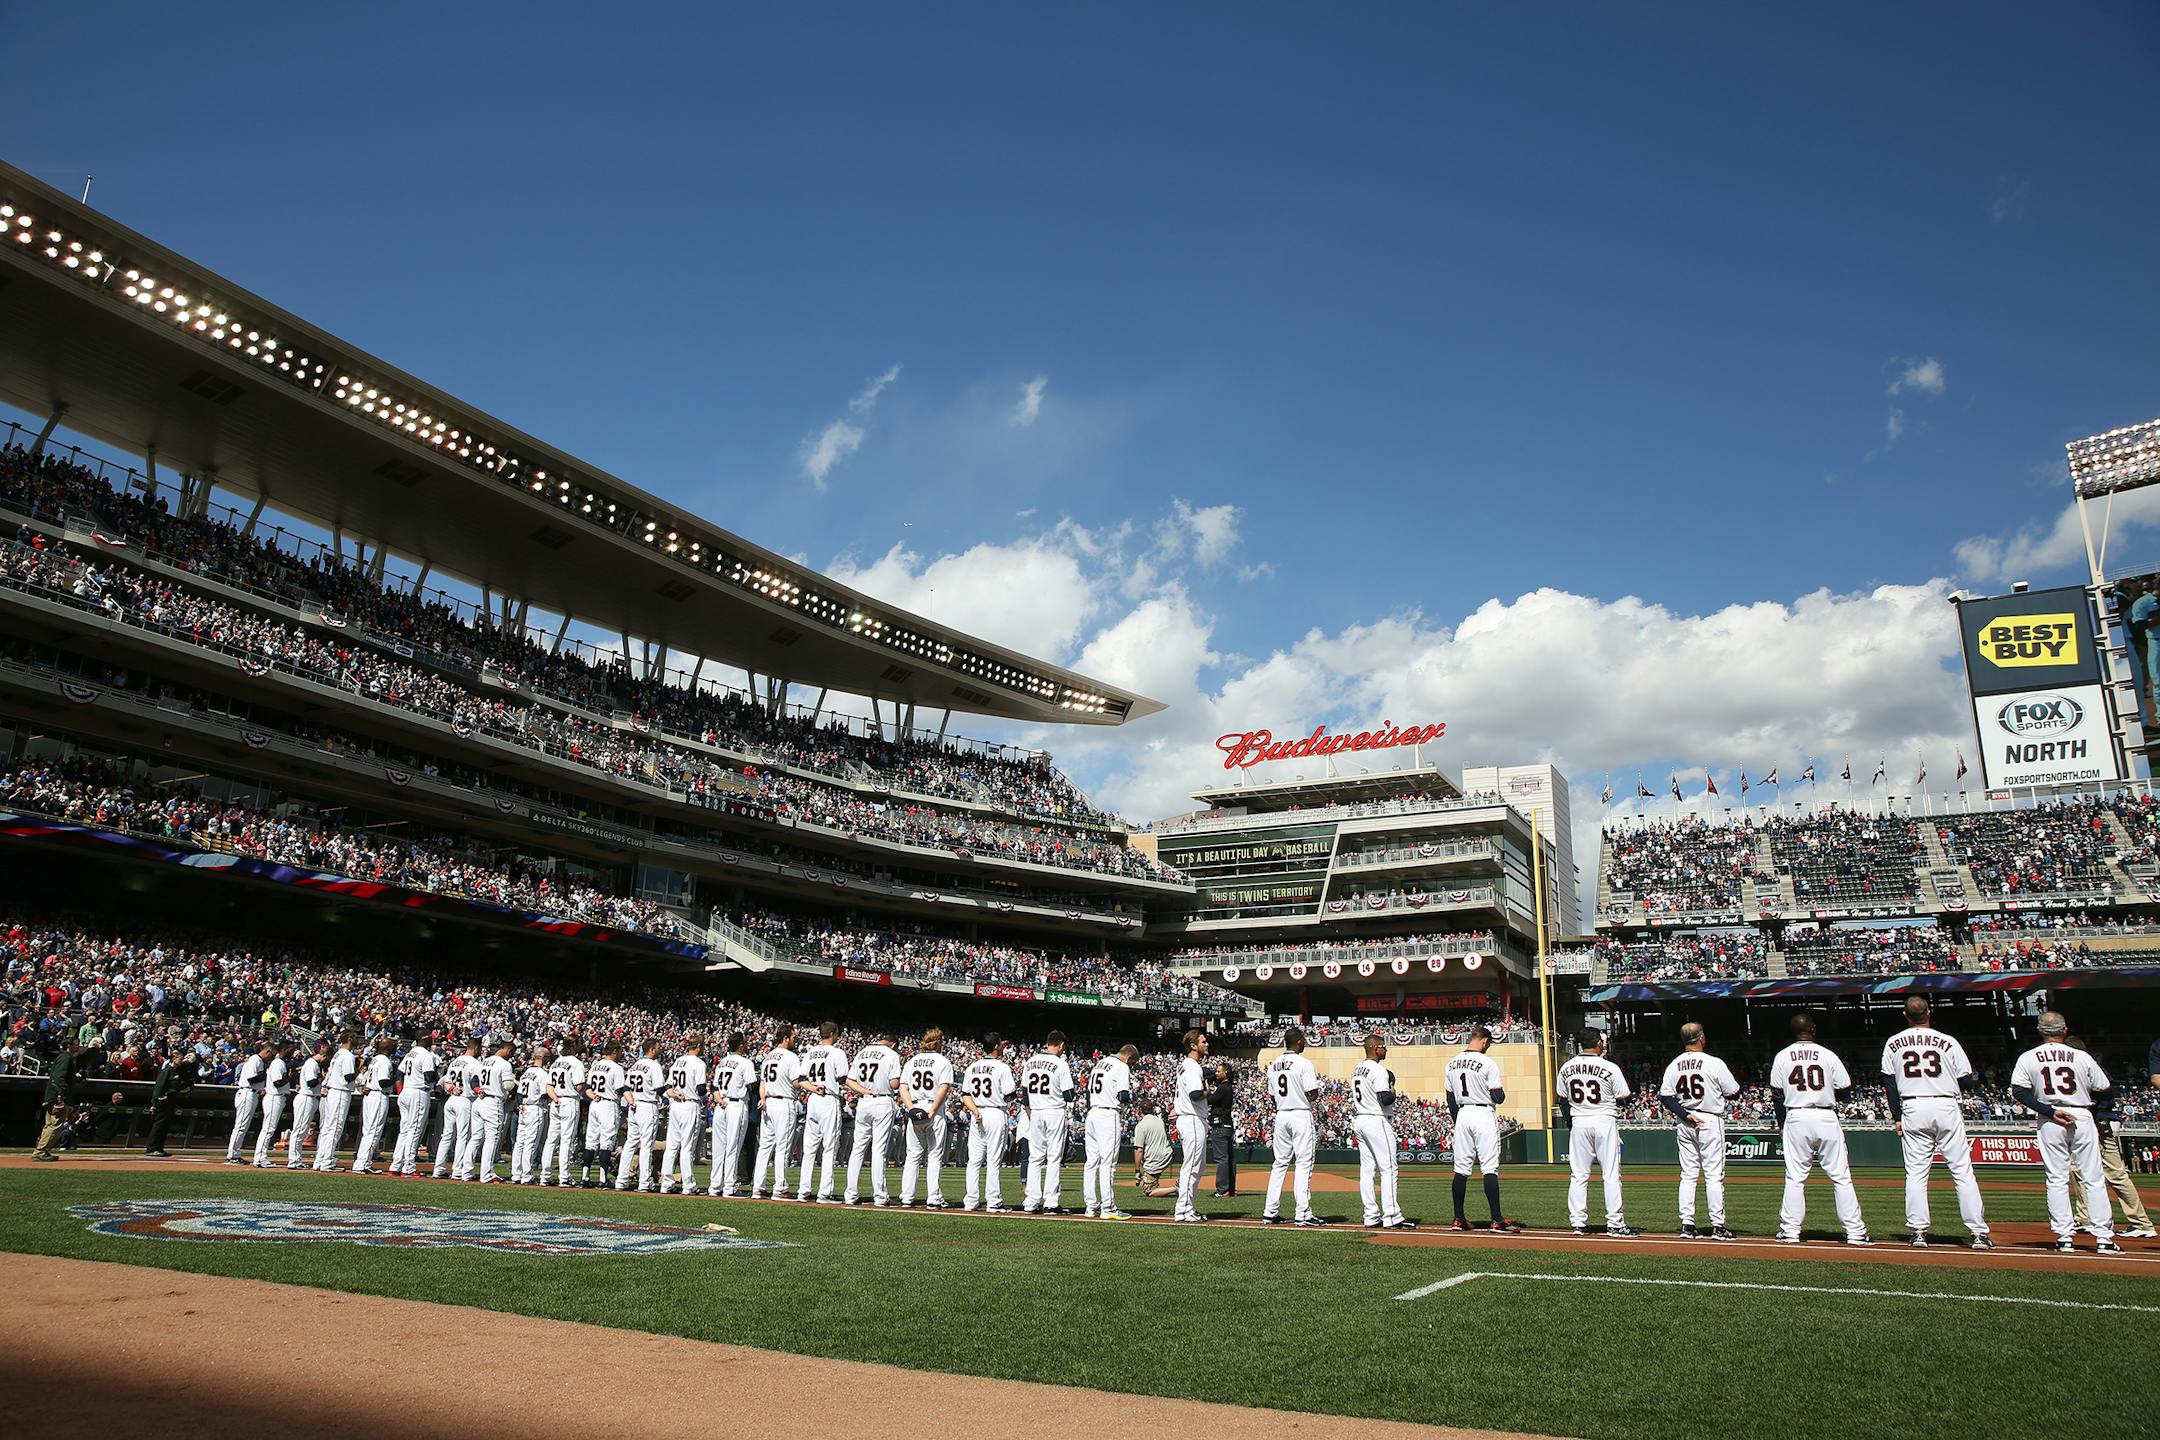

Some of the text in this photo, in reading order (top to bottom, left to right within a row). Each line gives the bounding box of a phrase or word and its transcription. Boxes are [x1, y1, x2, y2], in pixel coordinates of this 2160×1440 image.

[1990, 623, 2073, 643] BEST
[1994, 641, 2068, 660] BUY
[2014, 701, 2065, 723] FOX
[2016, 719, 2068, 731] SPORTS
[1215, 720, 1447, 769] Budweiser
[2005, 739, 2087, 764] NORTH
[2003, 769, 2100, 786] FOXSPORTSNORTH.COM
[541, 815, 566, 828] DELTA
[596, 829, 625, 843] LEGENDS
[627, 837, 643, 847] CLUB
[1176, 853, 1194, 864] IT'S
[1196, 853, 1202, 863] A
[1205, 848, 1251, 862] BEAUTIFUL
[1253, 847, 1269, 858] DAY
[1286, 842, 1330, 855] BASEBALL
[1211, 886, 1313, 902] THIS IS TWINS TERRITORY
[2044, 900, 2066, 908] Home
[2068, 899, 2085, 908] Run
[2087, 897, 2110, 907] Porch
[1684, 916, 1702, 925] Home
[1720, 915, 1738, 924] Porch
[1851, 908, 1871, 917] Home
[1873, 908, 1888, 917] Run
[1889, 907, 1910, 916] Porch
[1327, 965, 1337, 974] 34
[1362, 963, 1370, 972] 14
[1470, 956, 1475, 966] 3
[1226, 970, 1236, 978] 42
[1260, 968, 1268, 976] 10
[1058, 994, 1098, 1005] StarTribune
[1888, 1035, 1953, 1053] BRUNANSKY
[913, 1059, 935, 1068] BOYER
[1790, 1049, 1820, 1062] DAVIS
[1902, 1050, 1943, 1079] 23
[2035, 1050, 2075, 1063] GLYNN
[764, 1063, 778, 1082] 45
[809, 1062, 826, 1082] 44
[859, 1063, 879, 1083] 37
[1026, 1061, 1058, 1074] STAUFFER
[1448, 1059, 1483, 1073] SCHAFER
[1560, 1063, 1613, 1082] HERNANDEZ
[450, 1070, 463, 1087] 24
[481, 1069, 491, 1086] 31
[551, 1071, 566, 1089] 64
[591, 1074, 606, 1092] 62
[629, 1074, 644, 1092] 52
[672, 1070, 686, 1089] 50
[718, 1071, 732, 1090] 47
[912, 1070, 934, 1091] 36
[1029, 1073, 1050, 1095] 22
[1090, 1073, 1104, 1094] 15
[1278, 1074, 1288, 1097] 9
[1459, 1072, 1469, 1097] 1
[1788, 1064, 1825, 1092] 40
[2040, 1066, 2078, 1096] 13
[971, 1077, 992, 1098] 33
[1354, 1080, 1362, 1102] 5
[1569, 1079, 1601, 1104] 63
[1675, 1074, 1705, 1100] 46
[1725, 1141, 1768, 1159] Cargill
[1980, 1138, 2006, 1149] THIS
[2008, 1138, 2039, 1150] BUD'S
[1982, 1151, 2032, 1161] FOR YOU.
